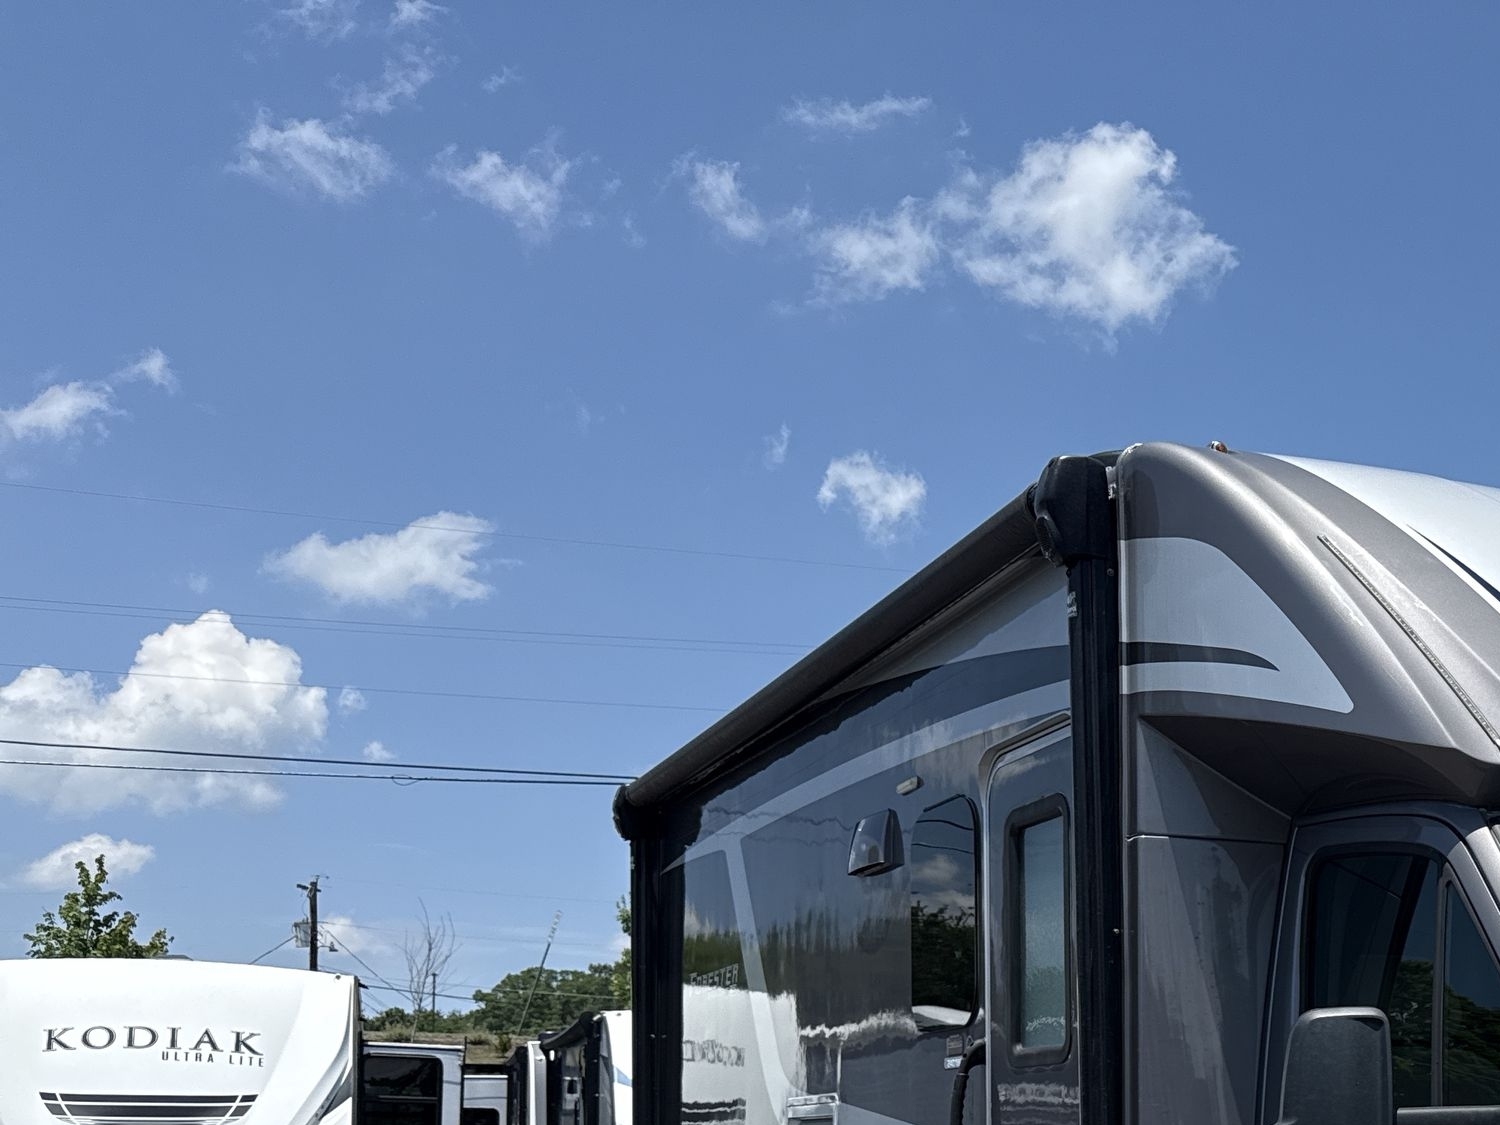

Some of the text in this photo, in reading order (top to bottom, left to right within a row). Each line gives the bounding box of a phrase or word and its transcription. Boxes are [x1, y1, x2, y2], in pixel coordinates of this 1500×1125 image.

[42, 1025, 264, 1056] KODIAK
[161, 1051, 265, 1068] ULTRA LITE
